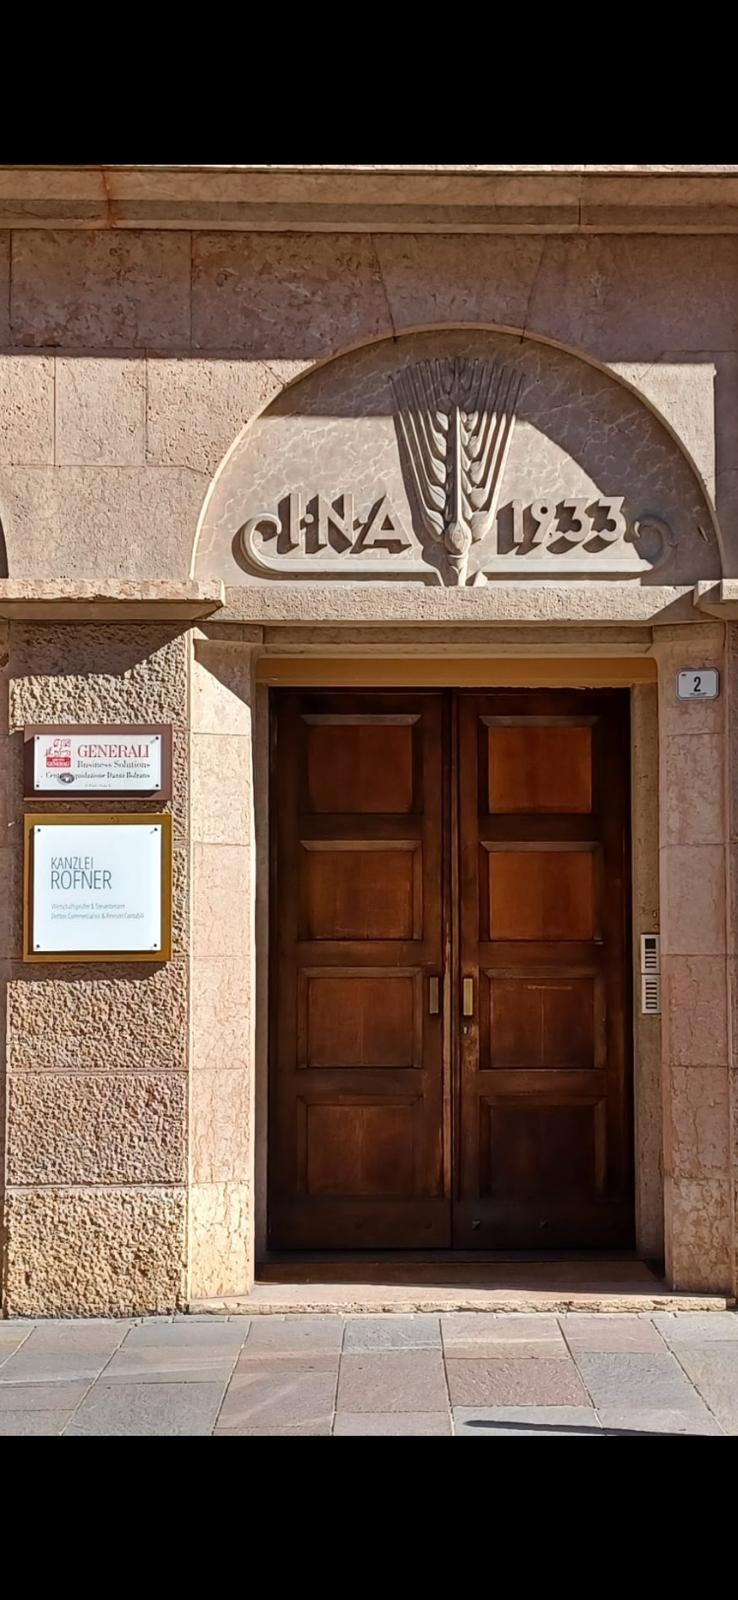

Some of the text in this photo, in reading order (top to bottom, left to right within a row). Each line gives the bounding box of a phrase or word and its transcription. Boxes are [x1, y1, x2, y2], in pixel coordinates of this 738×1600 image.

[502, 496, 627, 551] 1933
[693, 676, 702, 693] 2
[77, 744, 150, 758] GENERALI
[77, 760, 151, 769] Business Solutions
[51, 856, 94, 870] KANZLEI
[51, 870, 112, 890] ROFNER
